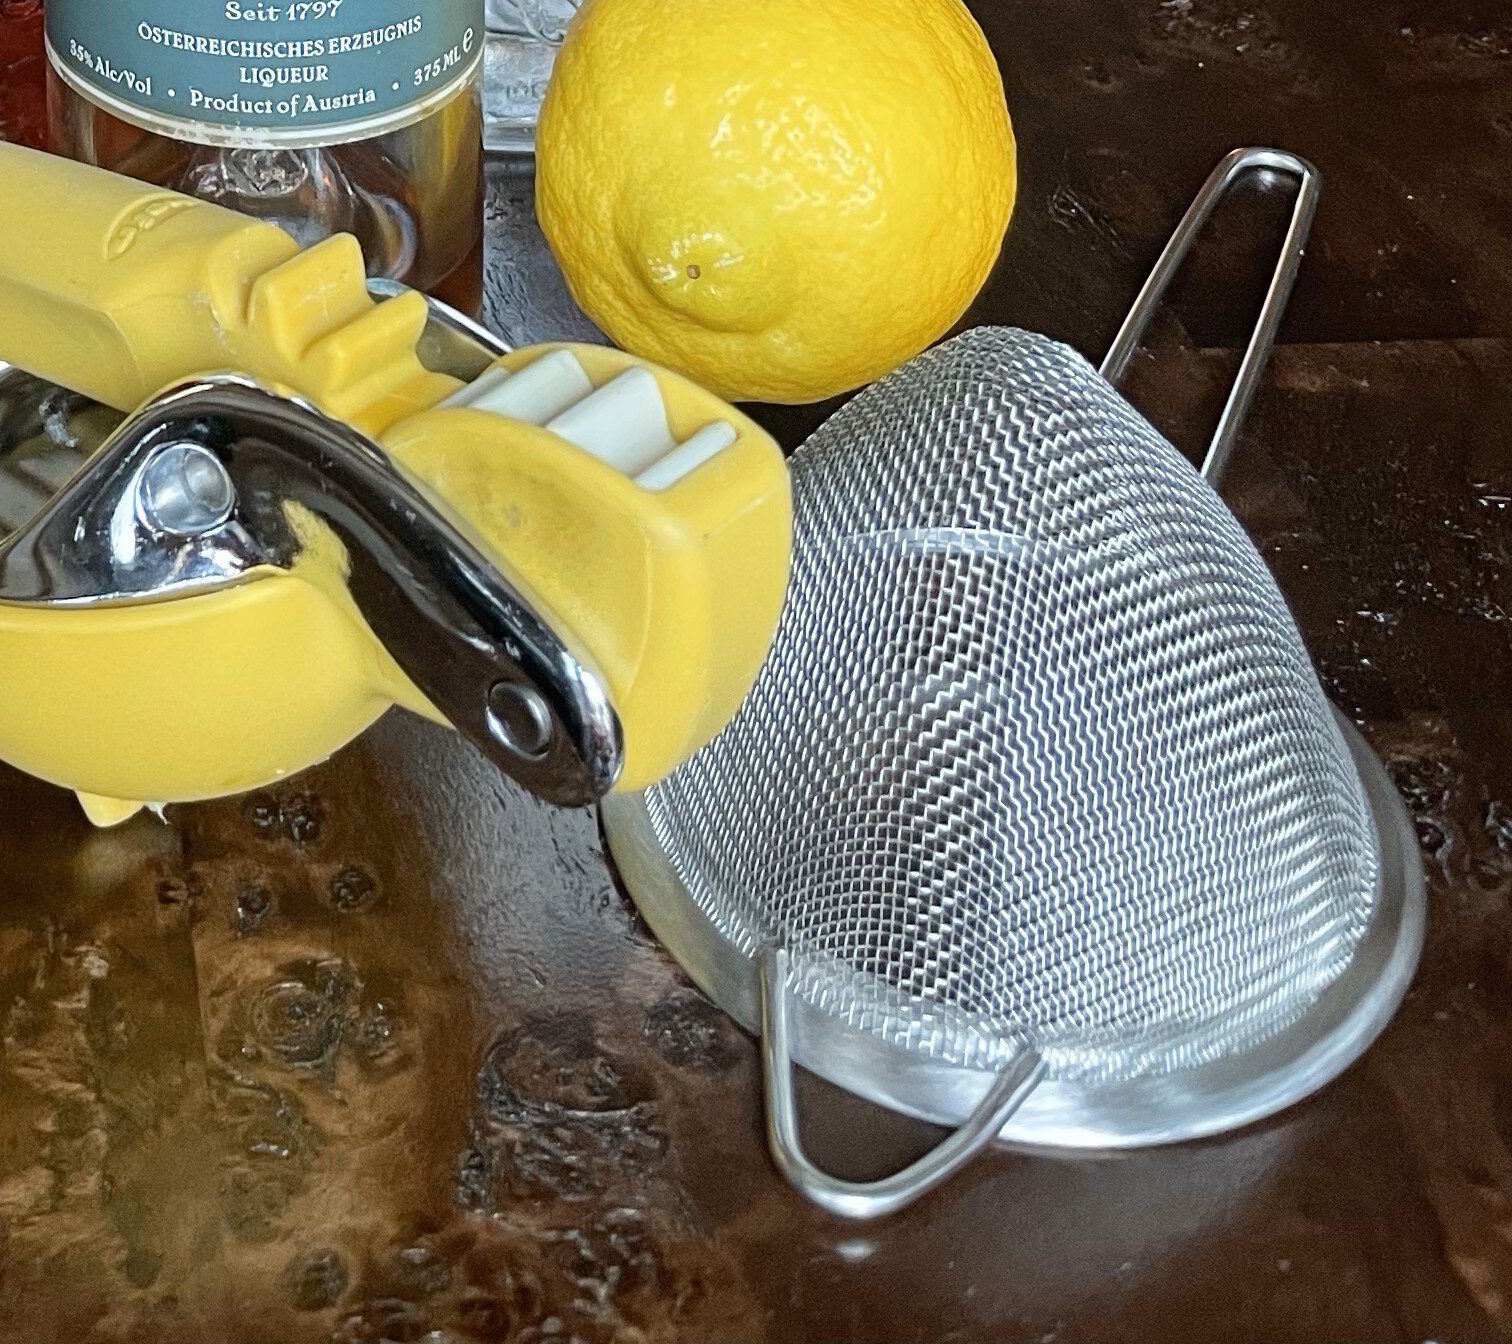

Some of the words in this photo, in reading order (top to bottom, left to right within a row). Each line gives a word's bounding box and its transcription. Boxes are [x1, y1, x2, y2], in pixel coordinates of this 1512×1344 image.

[225, 0, 282, 22] Seit
[285, 0, 344, 22] 1797
[328, 15, 423, 56] ERZEUGNIS
[69, 38, 94, 69] 35%
[94, 56, 153, 96] Alc/Vol
[190, 87, 273, 114] Product
[276, 93, 301, 118] of
[302, 87, 377, 113] Austria
[413, 58, 442, 87] 375
[442, 45, 462, 72] ML
[239, 64, 329, 88] LIQUEUR
